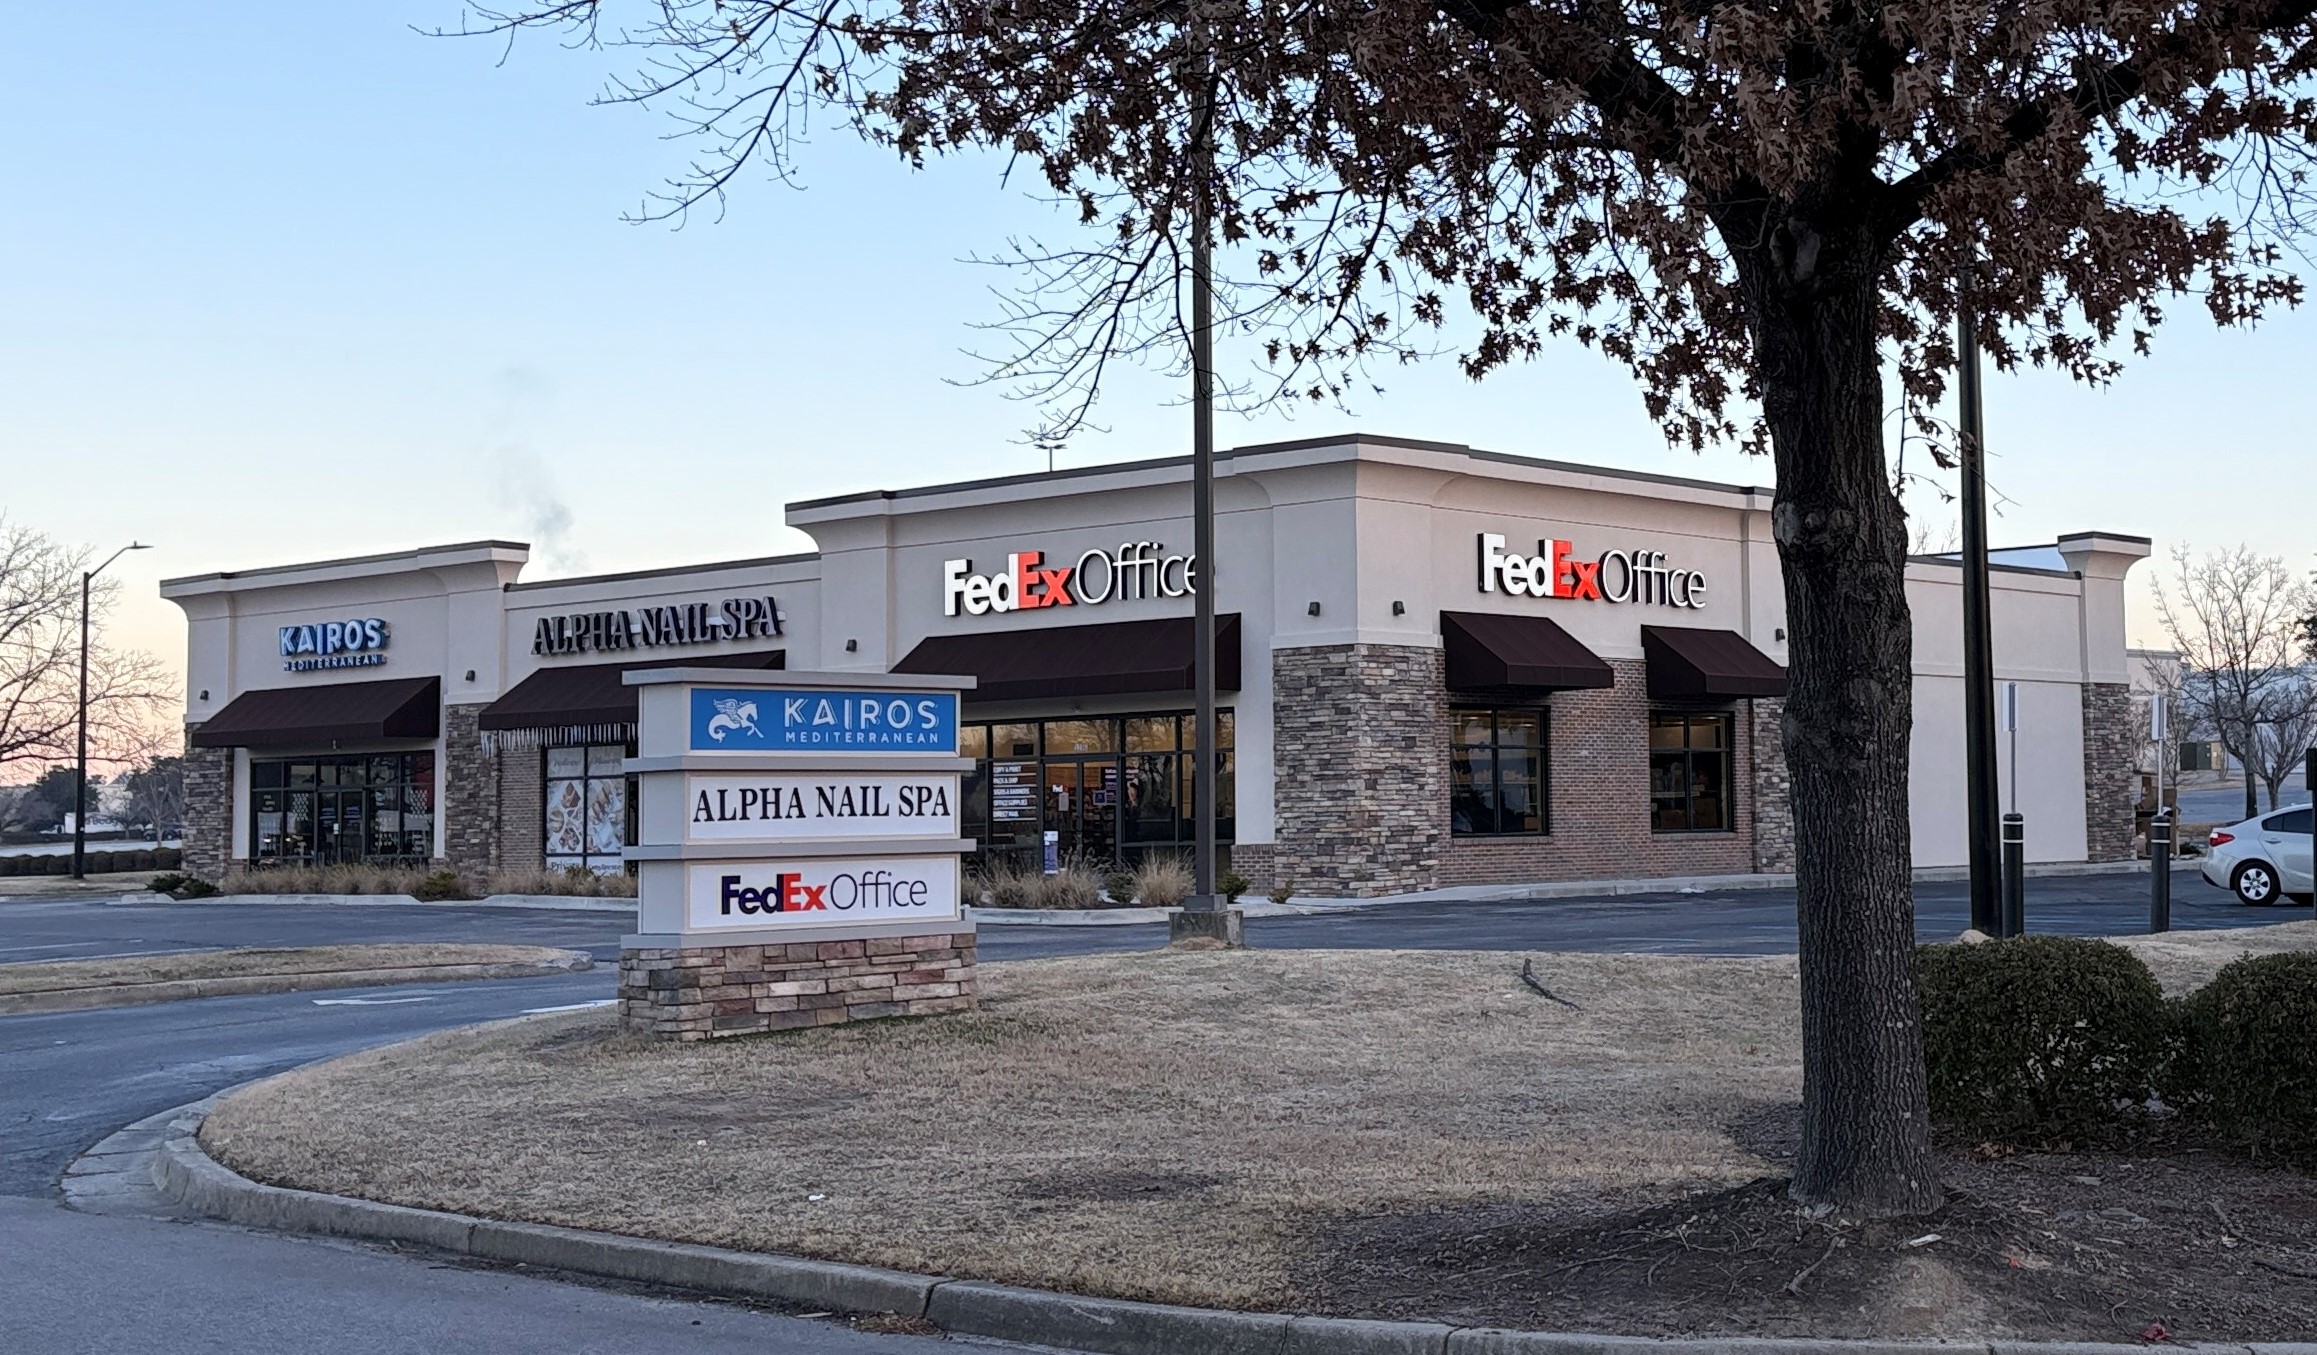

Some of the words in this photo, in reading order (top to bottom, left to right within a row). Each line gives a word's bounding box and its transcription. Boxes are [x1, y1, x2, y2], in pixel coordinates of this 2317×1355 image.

[945, 550, 1075, 617] FedEx
[1478, 532, 1600, 601] FedEx
[1599, 549, 1707, 609] Office
[279, 618, 386, 656] KAIROS
[530, 611, 635, 656] ALPHA
[637, 603, 709, 648] NAIL
[720, 596, 783, 641] SPA
[283, 654, 387, 672] MEDITERRANEAN
[784, 697, 940, 731] KAIROS
[785, 731, 939, 744] MEDITERRANEAN
[693, 787, 807, 823] ALPHA
[816, 785, 890, 818] NAIL
[899, 785, 951, 818] SPA
[721, 872, 828, 916] FedEx
[830, 870, 928, 910] Office
